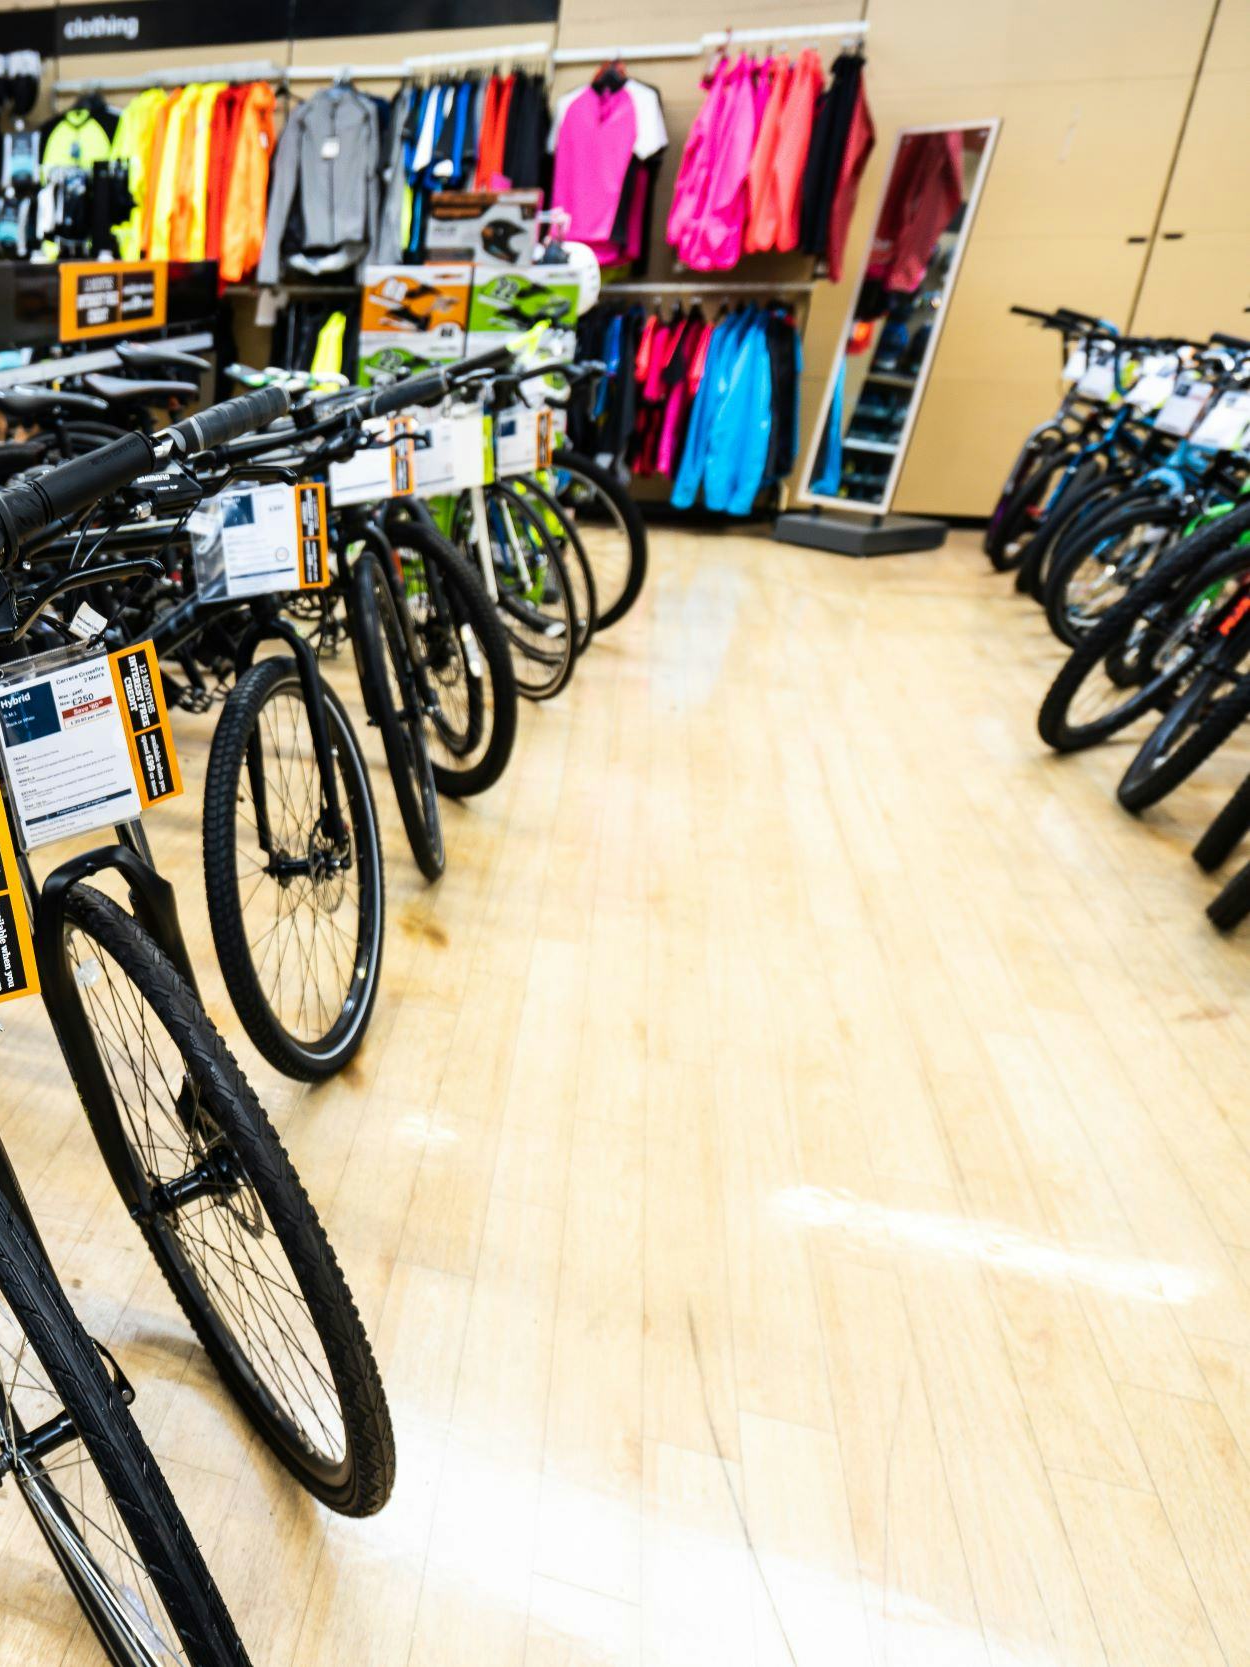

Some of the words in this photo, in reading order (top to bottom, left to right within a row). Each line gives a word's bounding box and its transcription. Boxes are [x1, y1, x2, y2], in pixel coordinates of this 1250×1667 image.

[63, 15, 139, 40] clothing
[56, 674, 77, 684] Carrera
[79, 665, 104, 677] Crossfire
[138, 663, 146, 674] 12
[72, 692, 94, 706] £250
[123, 676, 138, 713] CREDIT
[127, 654, 144, 702] INTEREST
[138, 702, 150, 727] FREE
[141, 674, 155, 714] MONTHS
[0, 692, 31, 710] Hybrid
[145, 753, 155, 772] £99
[0, 945, 13, 969] when
[4, 970, 15, 988] you
